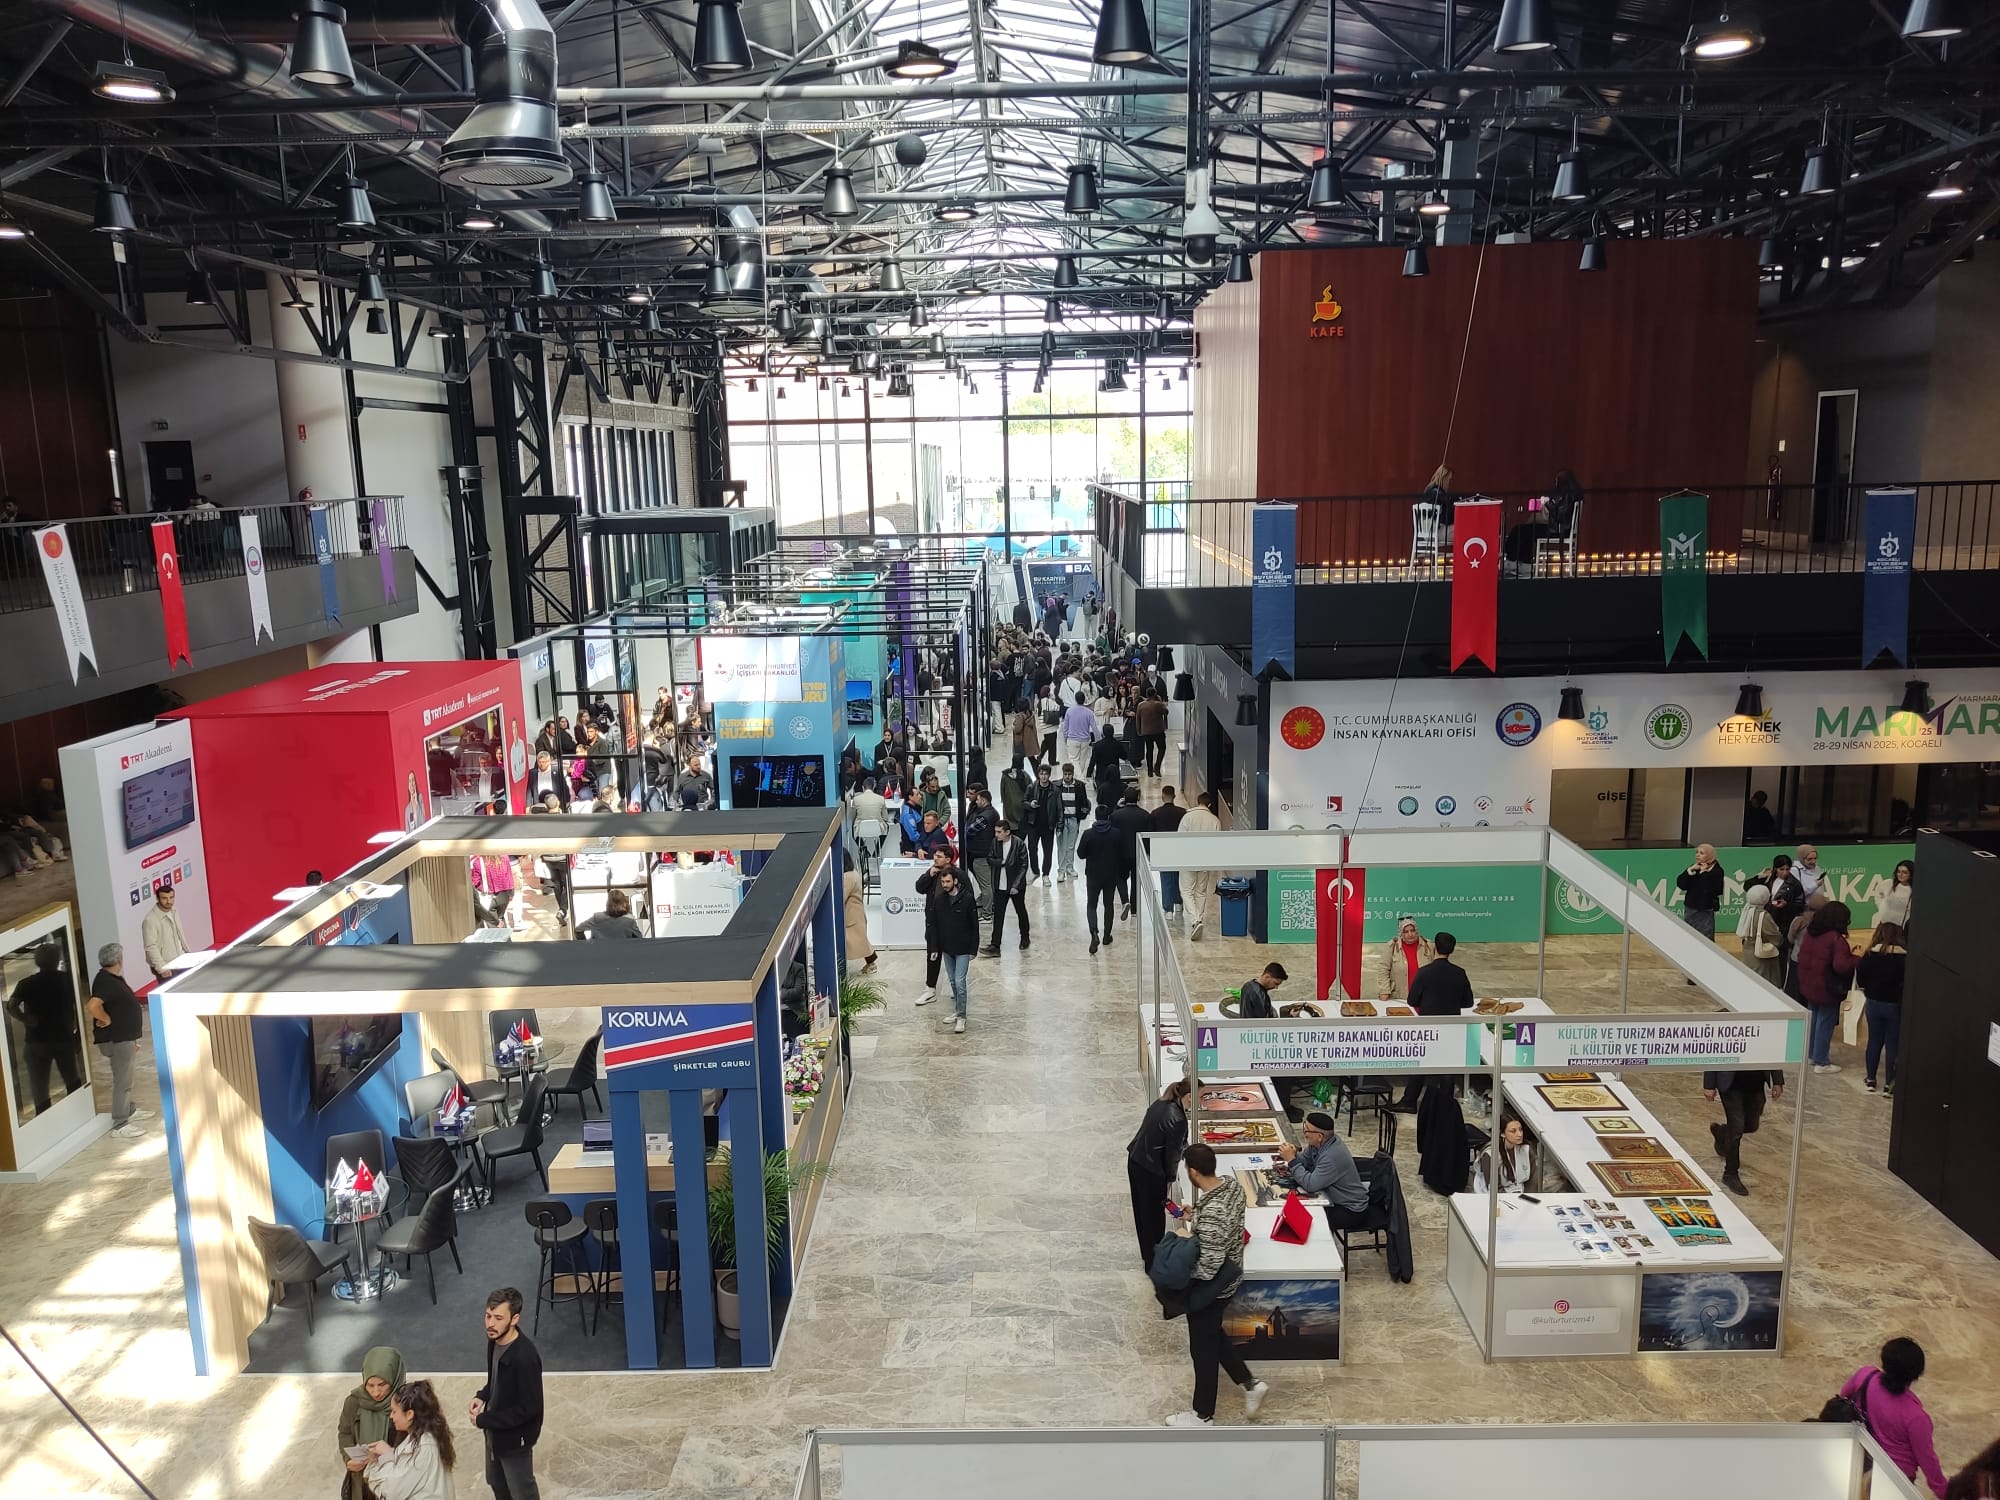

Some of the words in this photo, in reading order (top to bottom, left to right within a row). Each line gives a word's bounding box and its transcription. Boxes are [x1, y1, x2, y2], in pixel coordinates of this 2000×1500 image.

[1310, 327, 1344, 337] KAFE
[1333, 716, 1352, 726] T.C.
[1354, 712, 1477, 726] CUMHURBAŞKANLIĞI
[1717, 721, 1782, 733] YETENEK
[1333, 728, 1368, 739] İNSAN
[1372, 728, 1443, 739] KAYNAKLARI
[1446, 726, 1477, 738] OFİSİ
[1719, 734, 1742, 745] HER
[1743, 734, 1781, 744] YERDE
[1813, 741, 1841, 750] 28-29
[1843, 740, 1873, 750] NİSAN
[1873, 739, 1899, 750] 2025,
[1901, 737, 1942, 749] KOCAELİ
[129, 753, 144, 766] TRT
[144, 743, 173, 761] Akademi
[608, 1009, 689, 1028] KORUMA
[1202, 1028, 1215, 1048] A
[1239, 1029, 1279, 1044] KÜLTÜR
[1281, 1031, 1294, 1044] VE
[1338, 1027, 1393, 1042] BAKANLIĞI
[1519, 1025, 1533, 1044] A
[1558, 1026, 1598, 1041] KÜLTÜR
[1601, 1028, 1613, 1040] VE
[1658, 1024, 1714, 1039] BAKANLIĞI
[1264, 1044, 1303, 1059] KÜLTÜR
[1305, 1046, 1318, 1058] VE
[1362, 1042, 1426, 1057] MÜDÜRLÜĞÜ
[1582, 1041, 1622, 1056] KÜLTÜR
[1625, 1043, 1638, 1055] VE
[1682, 1039, 1747, 1054] MÜDÜRLÜĞÜ
[673, 1061, 718, 1072] ŞİRKETLER
[721, 1060, 751, 1068] GRUBU
